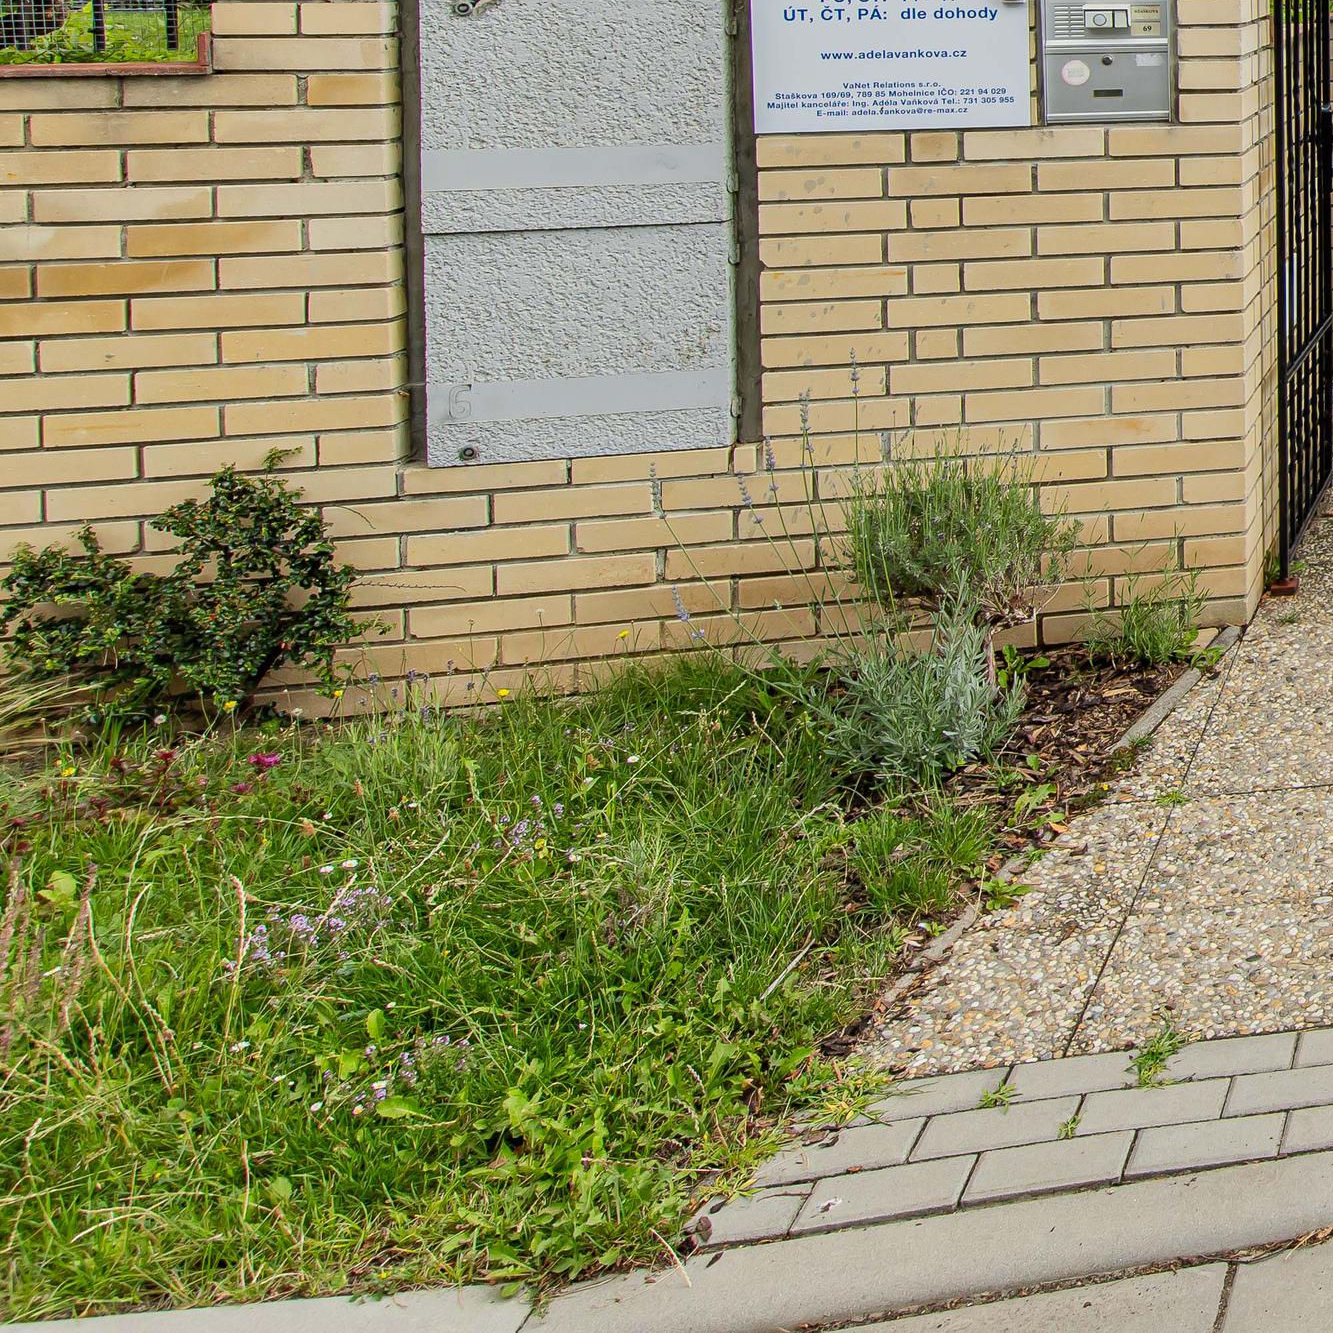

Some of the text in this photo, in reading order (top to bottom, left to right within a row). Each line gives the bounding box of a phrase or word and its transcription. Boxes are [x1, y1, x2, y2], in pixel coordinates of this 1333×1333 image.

[783, 4, 999, 24] ÚT, ČT, PÁ: dle dohody
[820, 48, 968, 61] www.adelavankova.cz
[873, 81, 916, 89] Relations
[775, 92, 818, 100] Staškova
[875, 90, 886, 98] 85
[888, 89, 935, 97] Mohelnice
[937, 87, 957, 96] IČO:
[960, 88, 975, 96] 221
[991, 87, 1007, 95] 029
[767, 102, 799, 110] Majitel
[801, 100, 850, 109] kanceláře:
[852, 100, 869, 109] Ing.
[872, 99, 898, 107] Adéla
[900, 98, 939, 106] Vaňková
[942, 97, 960, 105] Tel.:
[999, 96, 1015, 104] 955
[816, 109, 849, 117] E-mail:
